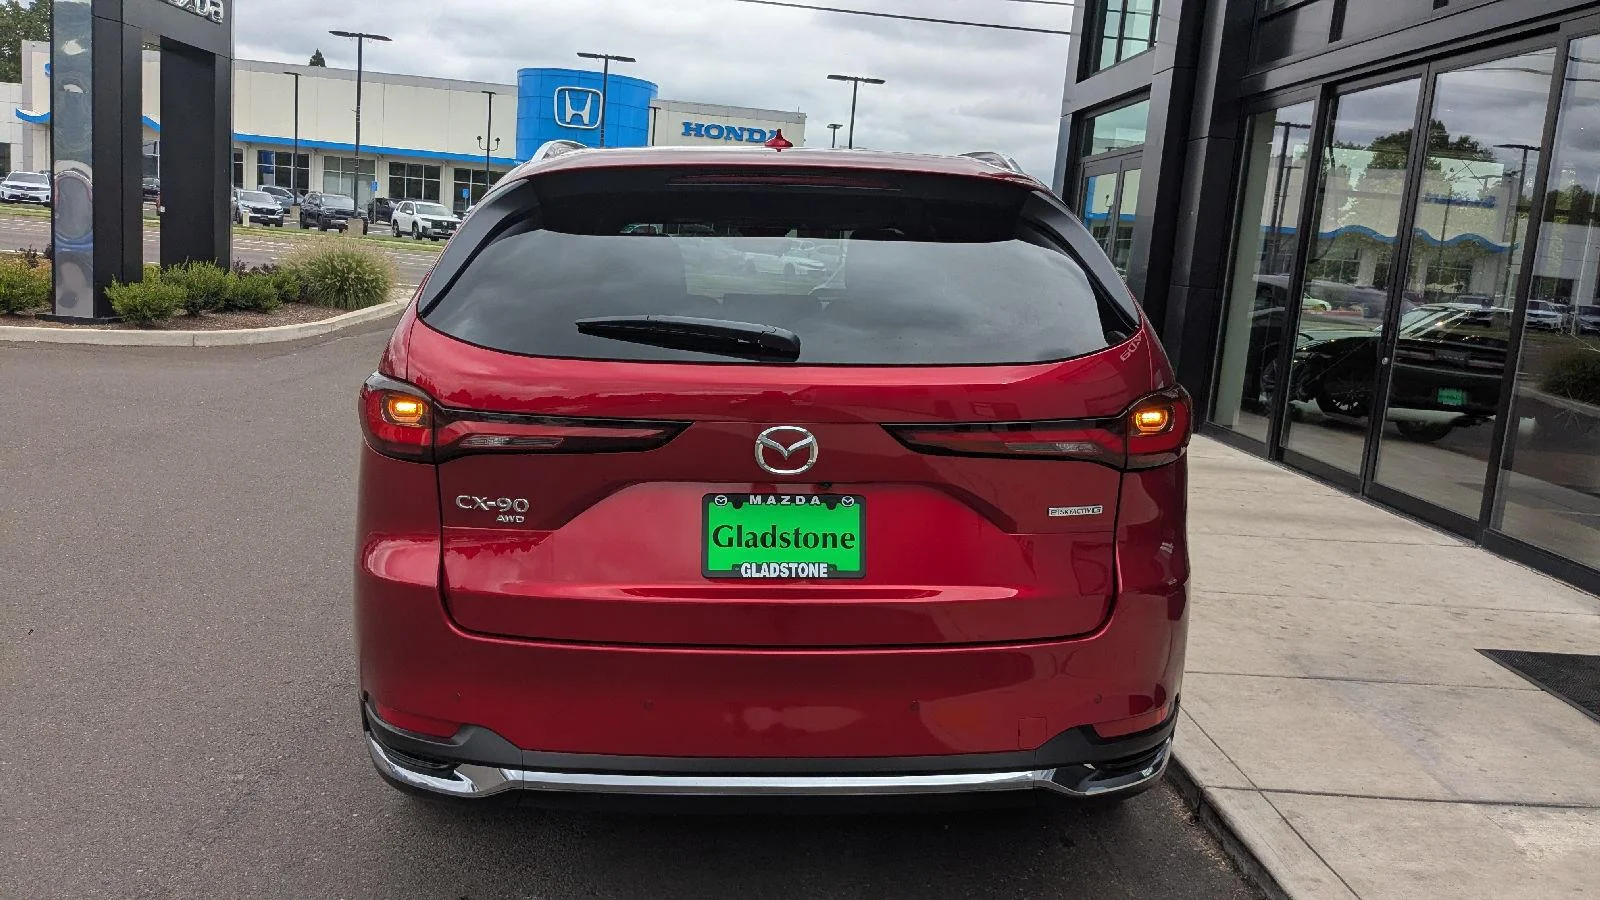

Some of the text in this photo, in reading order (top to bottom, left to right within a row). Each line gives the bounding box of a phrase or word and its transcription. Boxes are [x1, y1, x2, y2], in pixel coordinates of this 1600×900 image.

[455, 495, 530, 513] CX-90
[749, 495, 821, 505] MAZDA
[496, 515, 525, 523] AWD
[712, 524, 856, 549] Gladstone
[740, 562, 828, 578] GLADSTONE
